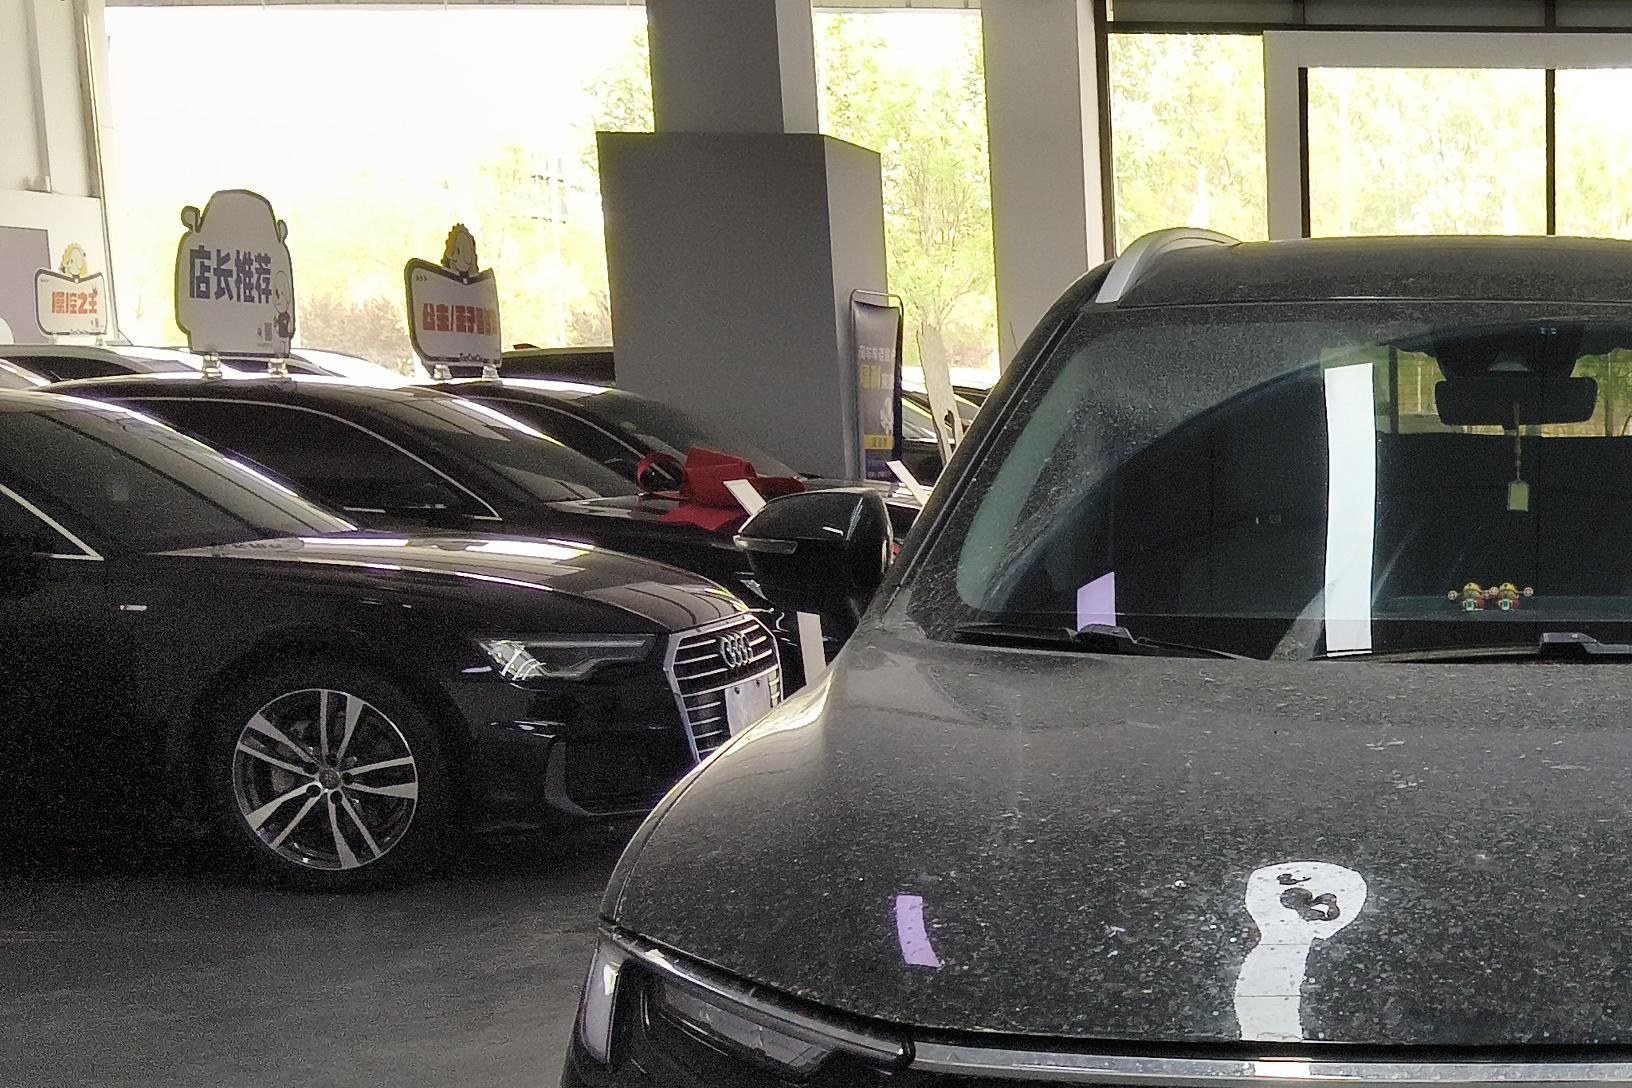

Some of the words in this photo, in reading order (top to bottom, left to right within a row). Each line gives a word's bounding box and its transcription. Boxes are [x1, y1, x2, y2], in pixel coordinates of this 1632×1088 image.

[190, 245, 272, 303] 店长推荐
[52, 291, 97, 314] 操控之王
